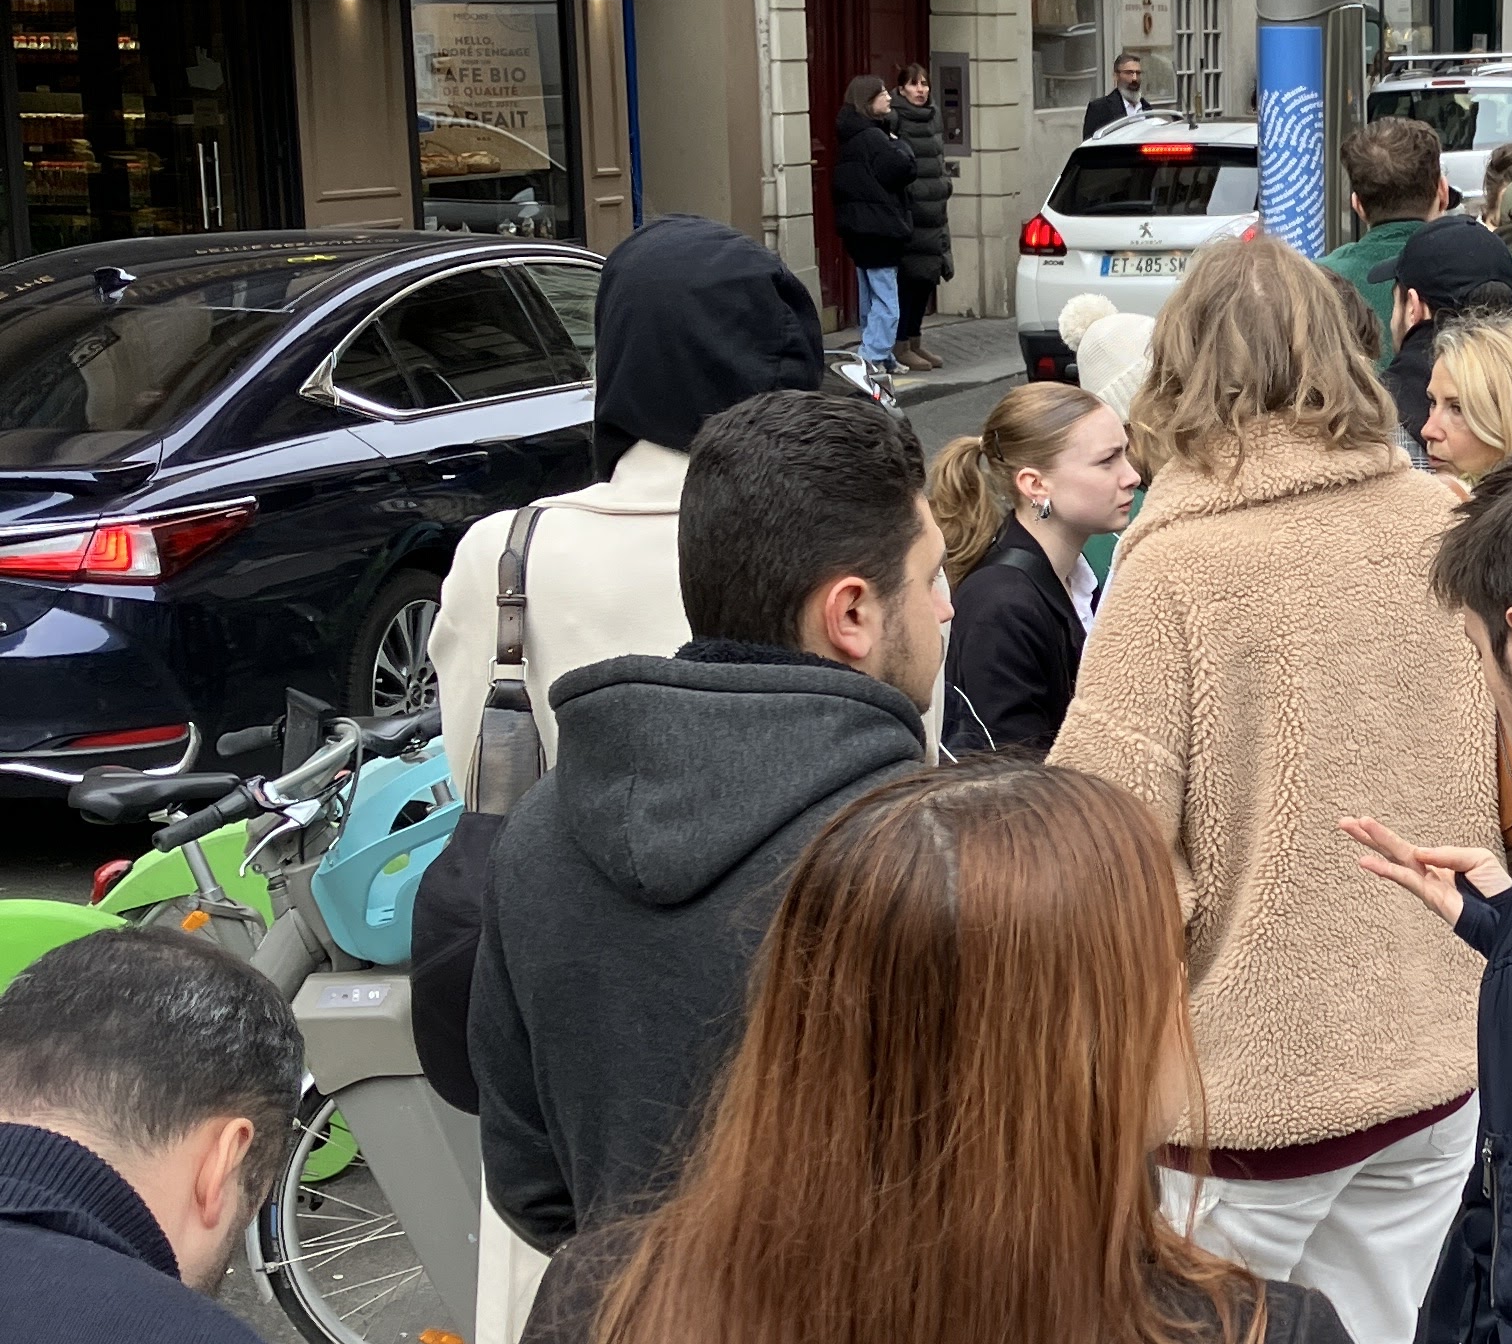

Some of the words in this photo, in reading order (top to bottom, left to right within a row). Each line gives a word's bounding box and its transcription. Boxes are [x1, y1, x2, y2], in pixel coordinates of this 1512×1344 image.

[454, 36, 495, 46] HELLO,
[490, 67, 526, 83] BIO
[464, 84, 519, 98] QUALITÉ
